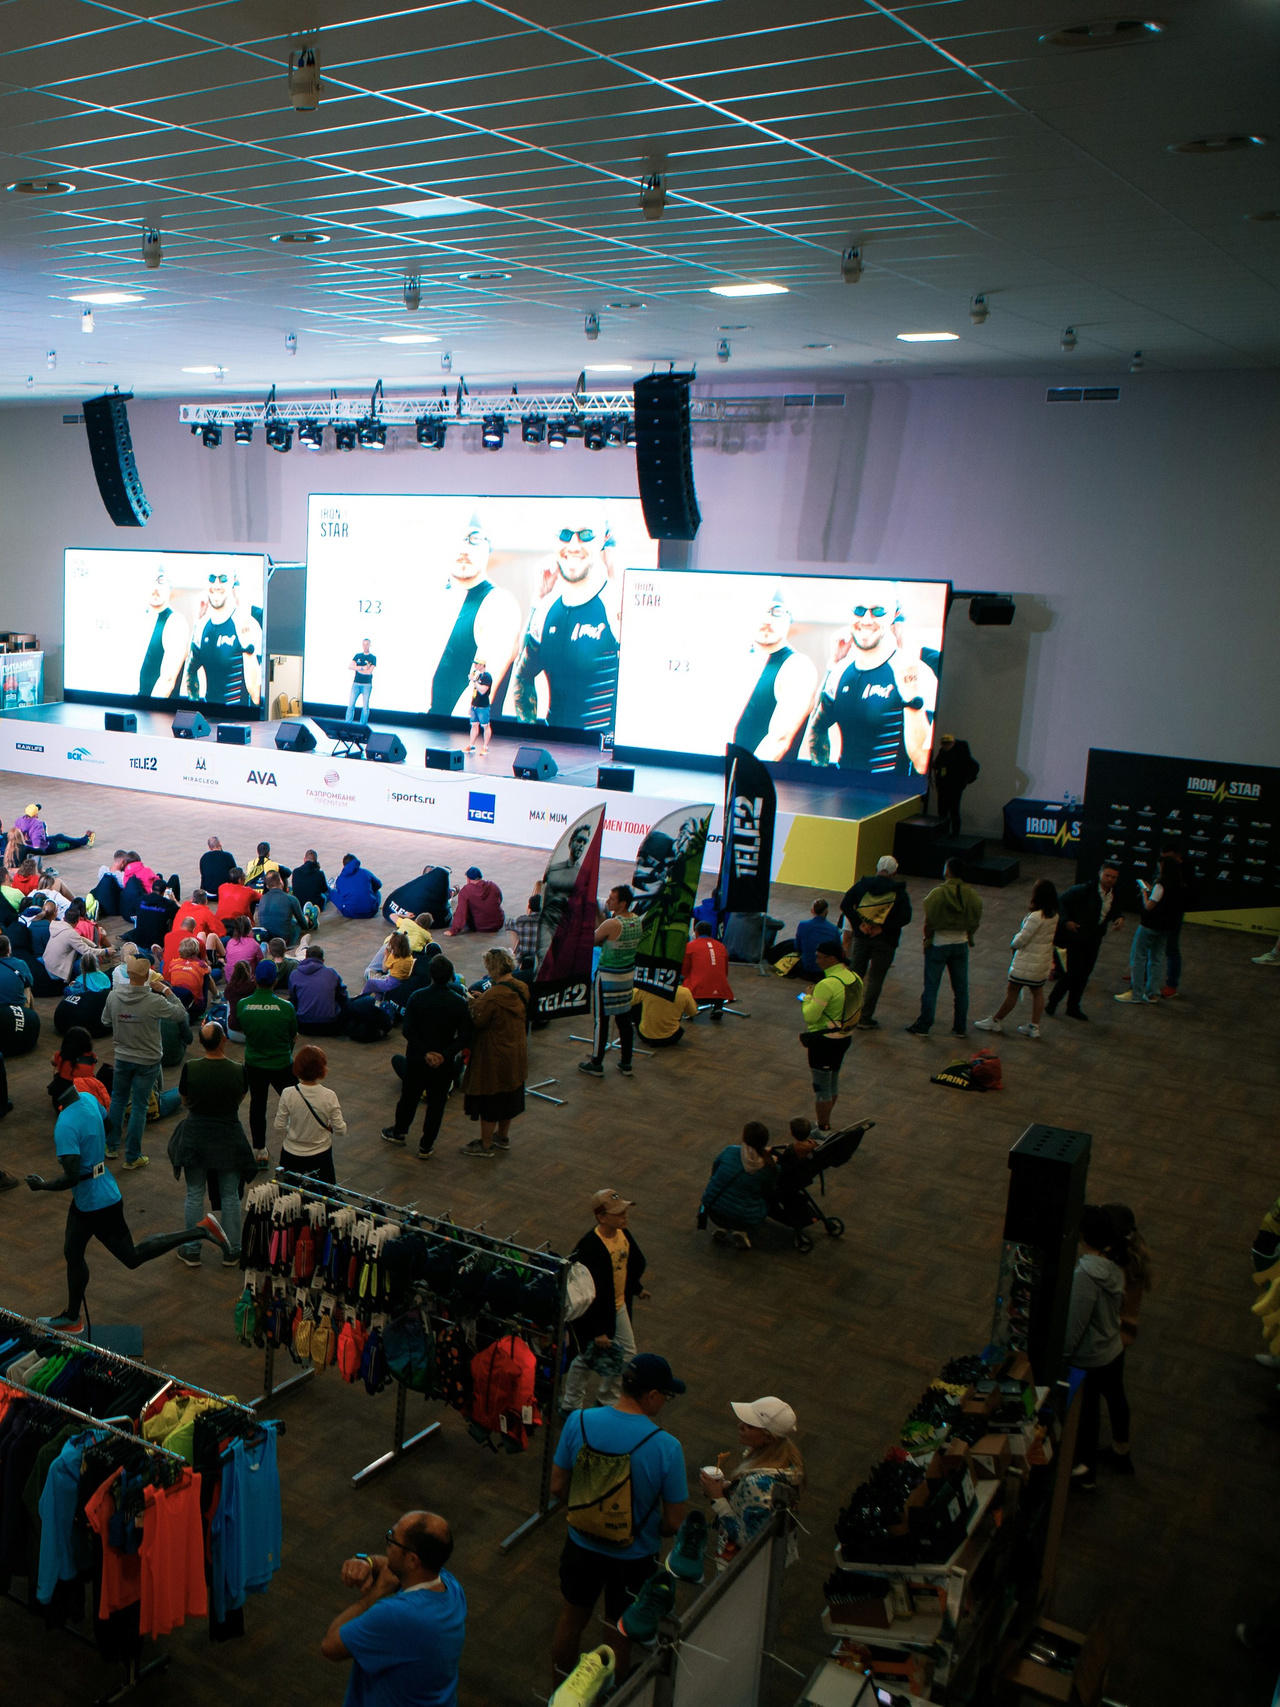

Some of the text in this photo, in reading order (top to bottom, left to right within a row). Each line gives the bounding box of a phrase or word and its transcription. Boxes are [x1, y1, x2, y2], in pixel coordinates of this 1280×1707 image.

[320, 507, 341, 520] IRON
[320, 521, 349, 538] STAR
[358, 599, 382, 614] 123
[634, 593, 661, 607] STAR
[668, 659, 690, 672] 123
[129, 757, 158, 771] TELE2
[182, 775, 219, 786] MIRACLEON
[246, 770, 278, 787] AVA
[306, 788, 356, 802] ГАЗПРОМБАНК
[1187, 776, 1262, 798] IRON STAR
[314, 797, 348, 808] ПРЕМИУМ
[391, 791, 436, 805] sports.ru
[603, 818, 651, 836] MEN TODAY
[1025, 816, 1058, 835] IRON
[734, 795, 763, 879] TELE2
[388, 900, 410, 916] TELE
[633, 965, 677, 992] ELE2
[538, 983, 587, 1013] TELE2
[9, 1004, 25, 1033] TELE2
